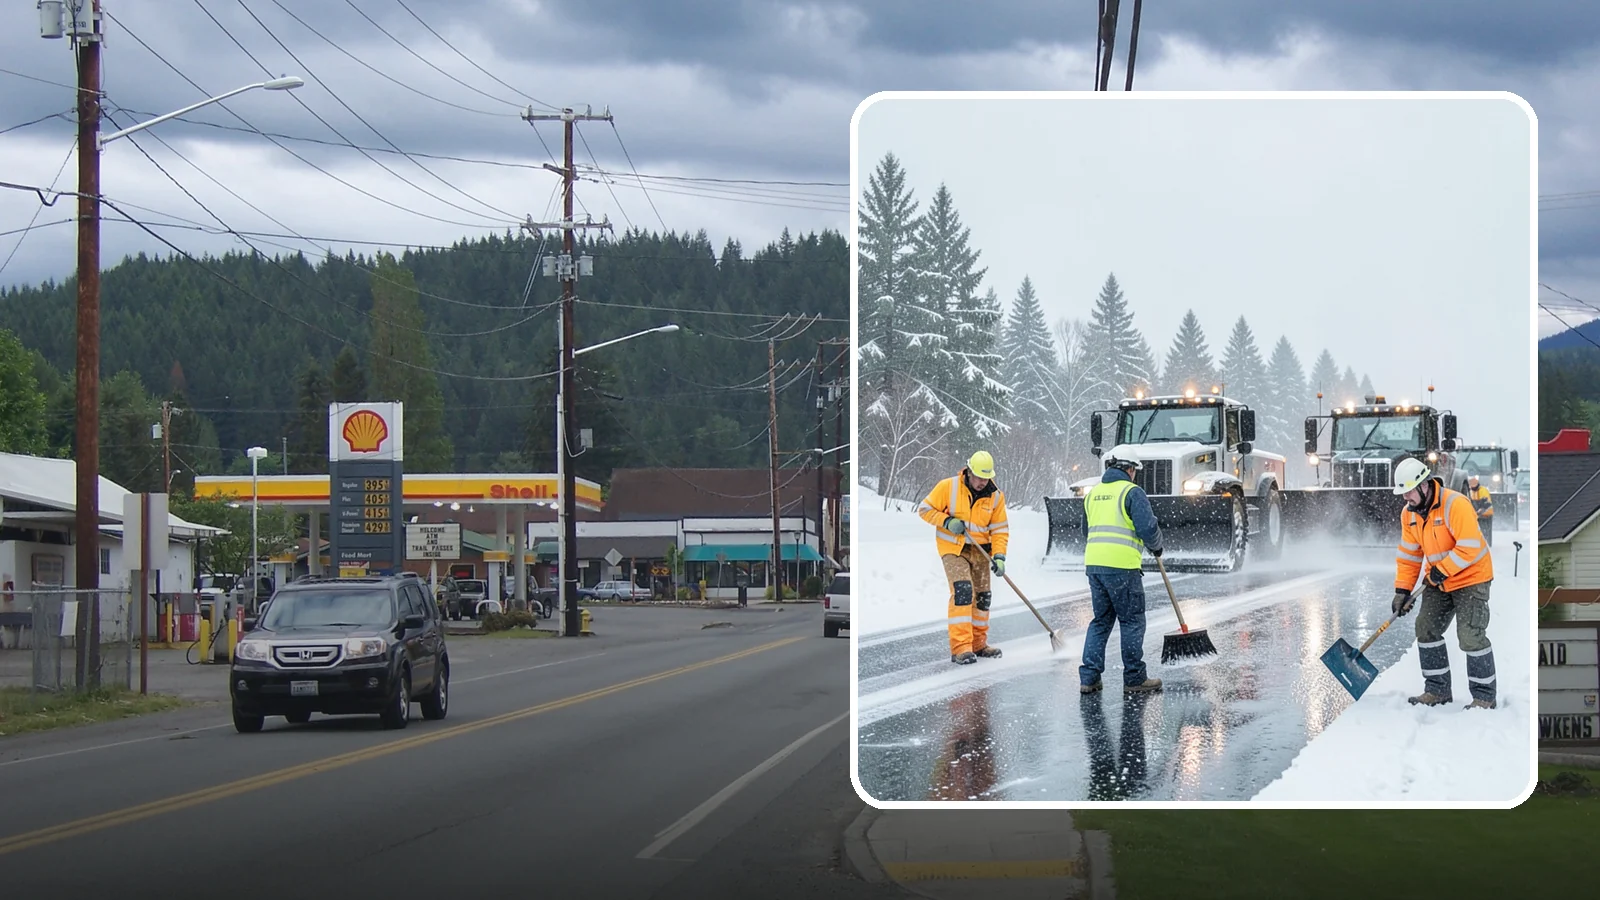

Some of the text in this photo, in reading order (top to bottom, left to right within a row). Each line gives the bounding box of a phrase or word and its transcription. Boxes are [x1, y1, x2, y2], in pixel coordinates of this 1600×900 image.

[365, 480, 384, 490] 395
[490, 484, 547, 499] Shell
[365, 494, 384, 504] 405
[365, 508, 384, 518] 415
[365, 522, 384, 532] 429
